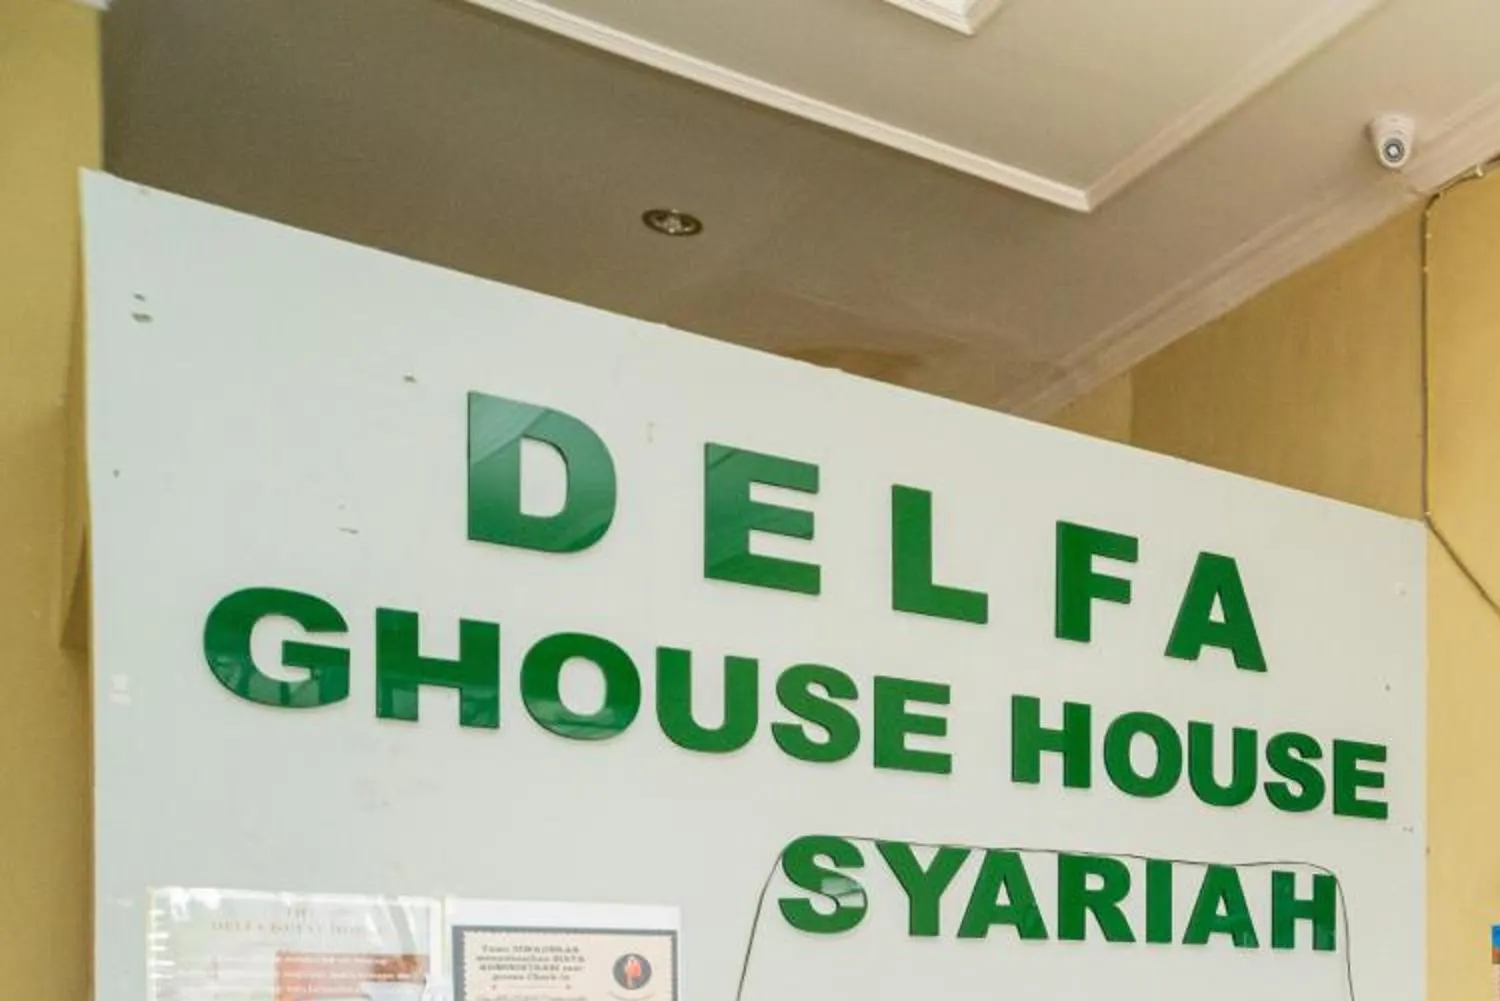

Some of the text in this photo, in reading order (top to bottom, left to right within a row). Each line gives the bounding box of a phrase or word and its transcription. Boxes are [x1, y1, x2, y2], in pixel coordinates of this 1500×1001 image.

[464, 392, 1267, 674] DELFA
[201, 585, 1391, 822] GHOUSE HOUSE
[777, 834, 1338, 954] SYARIAH
